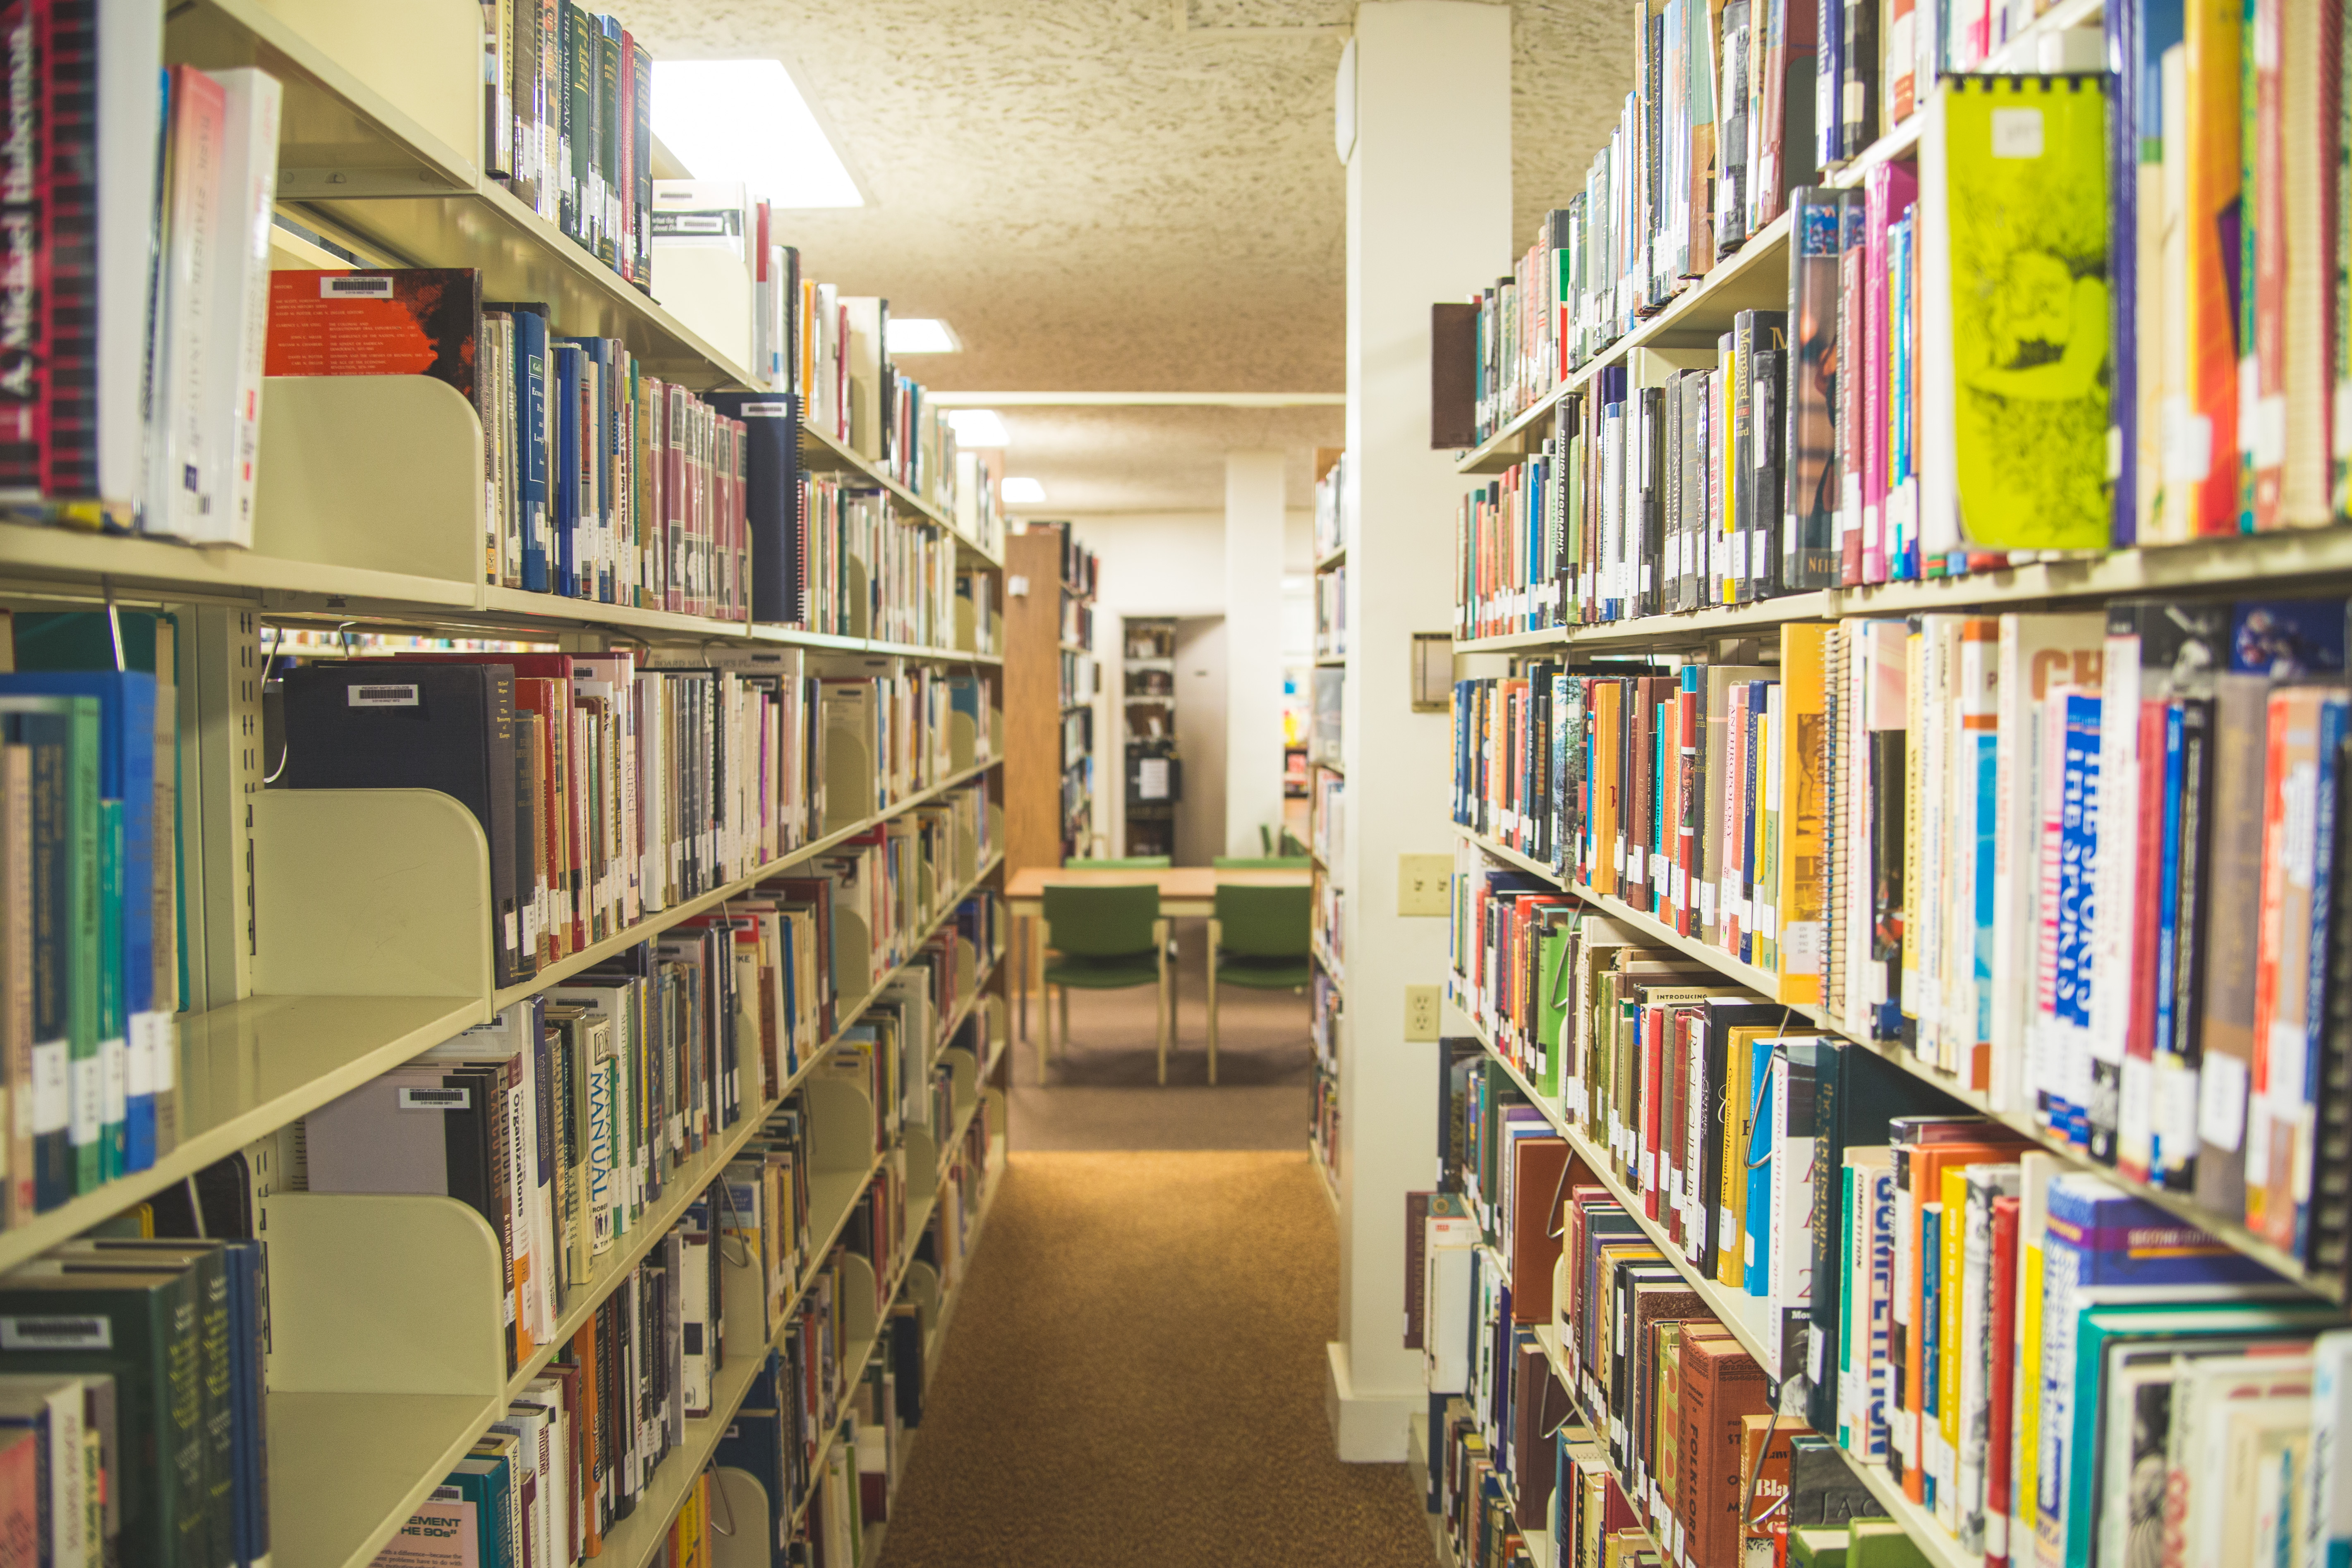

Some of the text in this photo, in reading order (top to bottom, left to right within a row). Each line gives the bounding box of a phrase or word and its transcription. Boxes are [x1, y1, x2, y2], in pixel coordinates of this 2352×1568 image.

[547, 12, 553, 31] OF
[1738, 327, 1751, 402] Margaret
[1727, 704, 1736, 840] ANTHROPOLOGY
[1907, 840, 1916, 951] TRAINING
[2057, 748, 2085, 1001] THE SPORTS
[490, 1089, 502, 1199] EXECUTION
[499, 1076, 511, 1185] EXECUTION
[513, 1093, 523, 1218] Organizations
[590, 1072, 607, 1202] MANUAL
[1870, 1175, 1891, 1455] COMPETITION
[1677, 1405, 1686, 1509] FOLKLOR
[1688, 1422, 1698, 1546] FOLKLORE
[1753, 1479, 1789, 1497] Bla
[407, 1516, 461, 1527] EMENT
